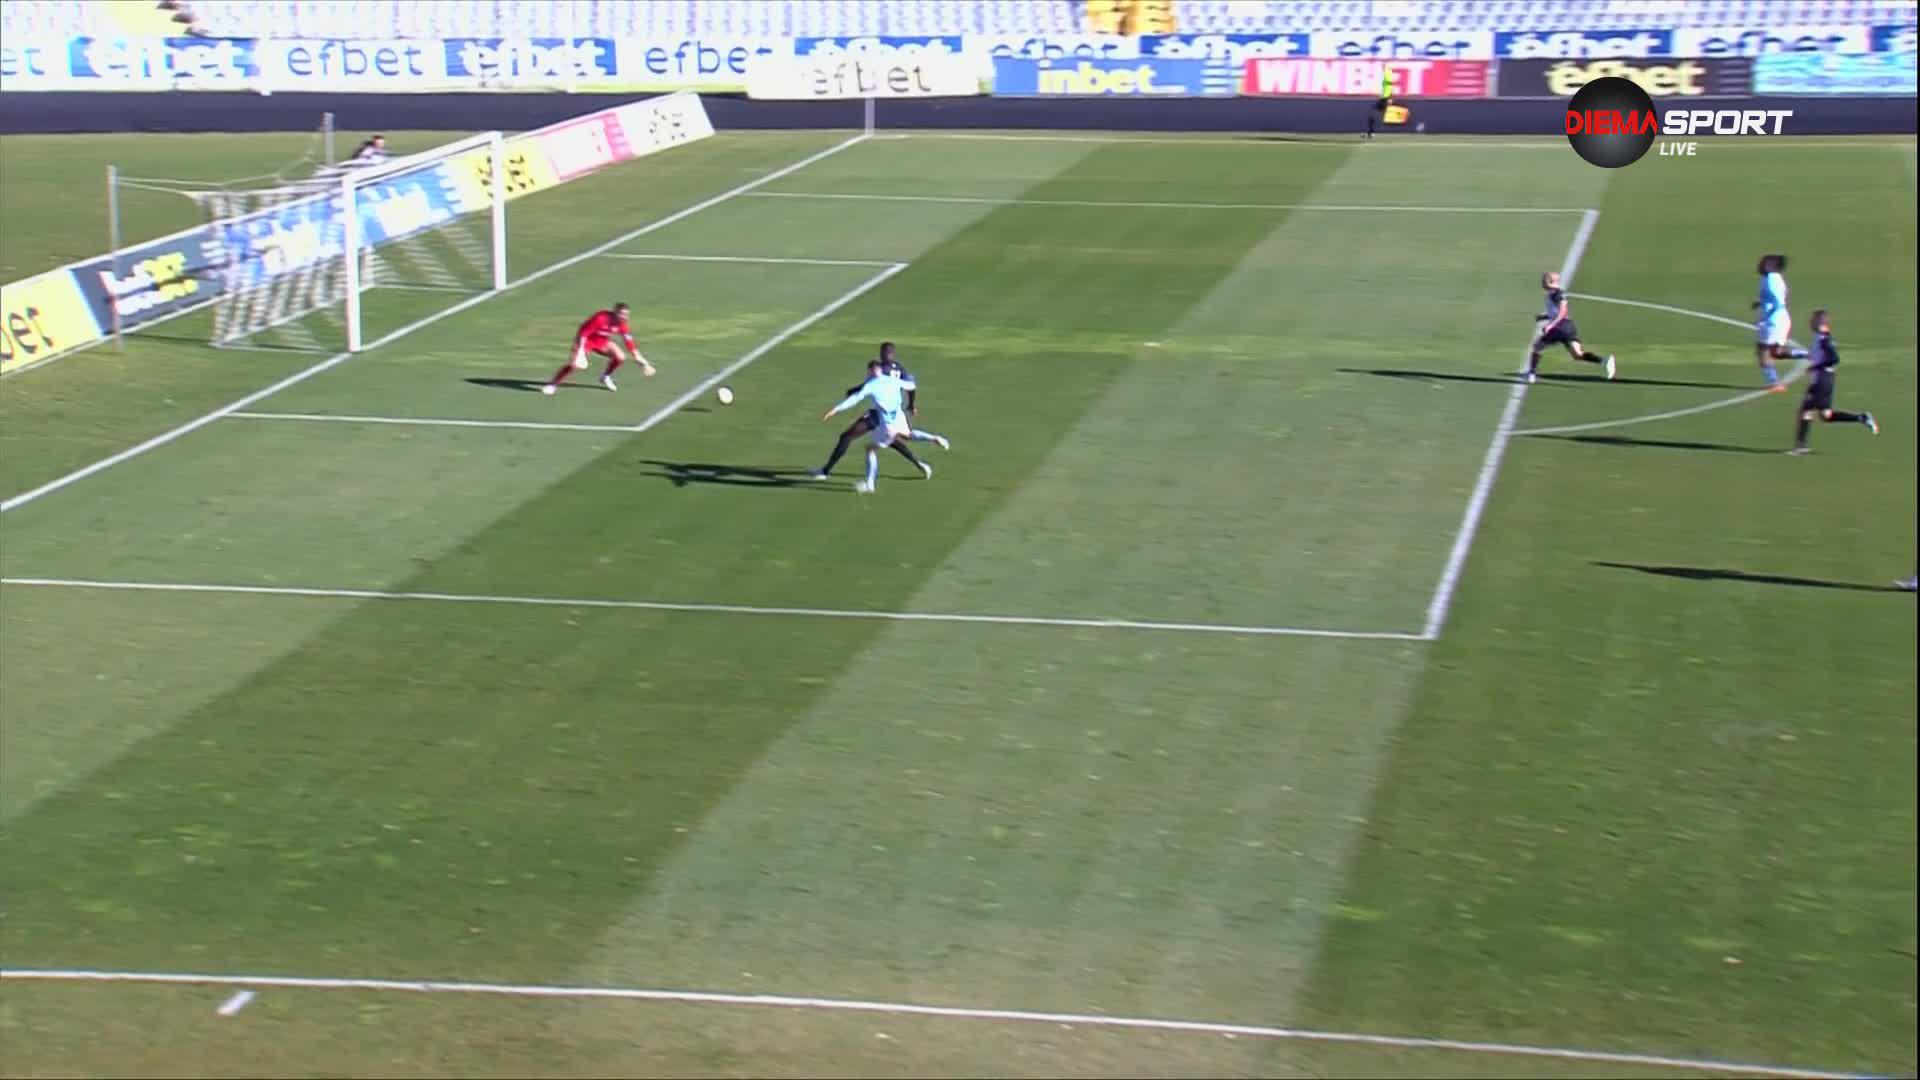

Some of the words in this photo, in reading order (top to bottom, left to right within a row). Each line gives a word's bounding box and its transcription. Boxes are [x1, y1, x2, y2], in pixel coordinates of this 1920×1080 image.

[286, 41, 425, 77] efbet
[1037, 60, 1156, 94] inbet
[1257, 60, 1434, 95] WINBET
